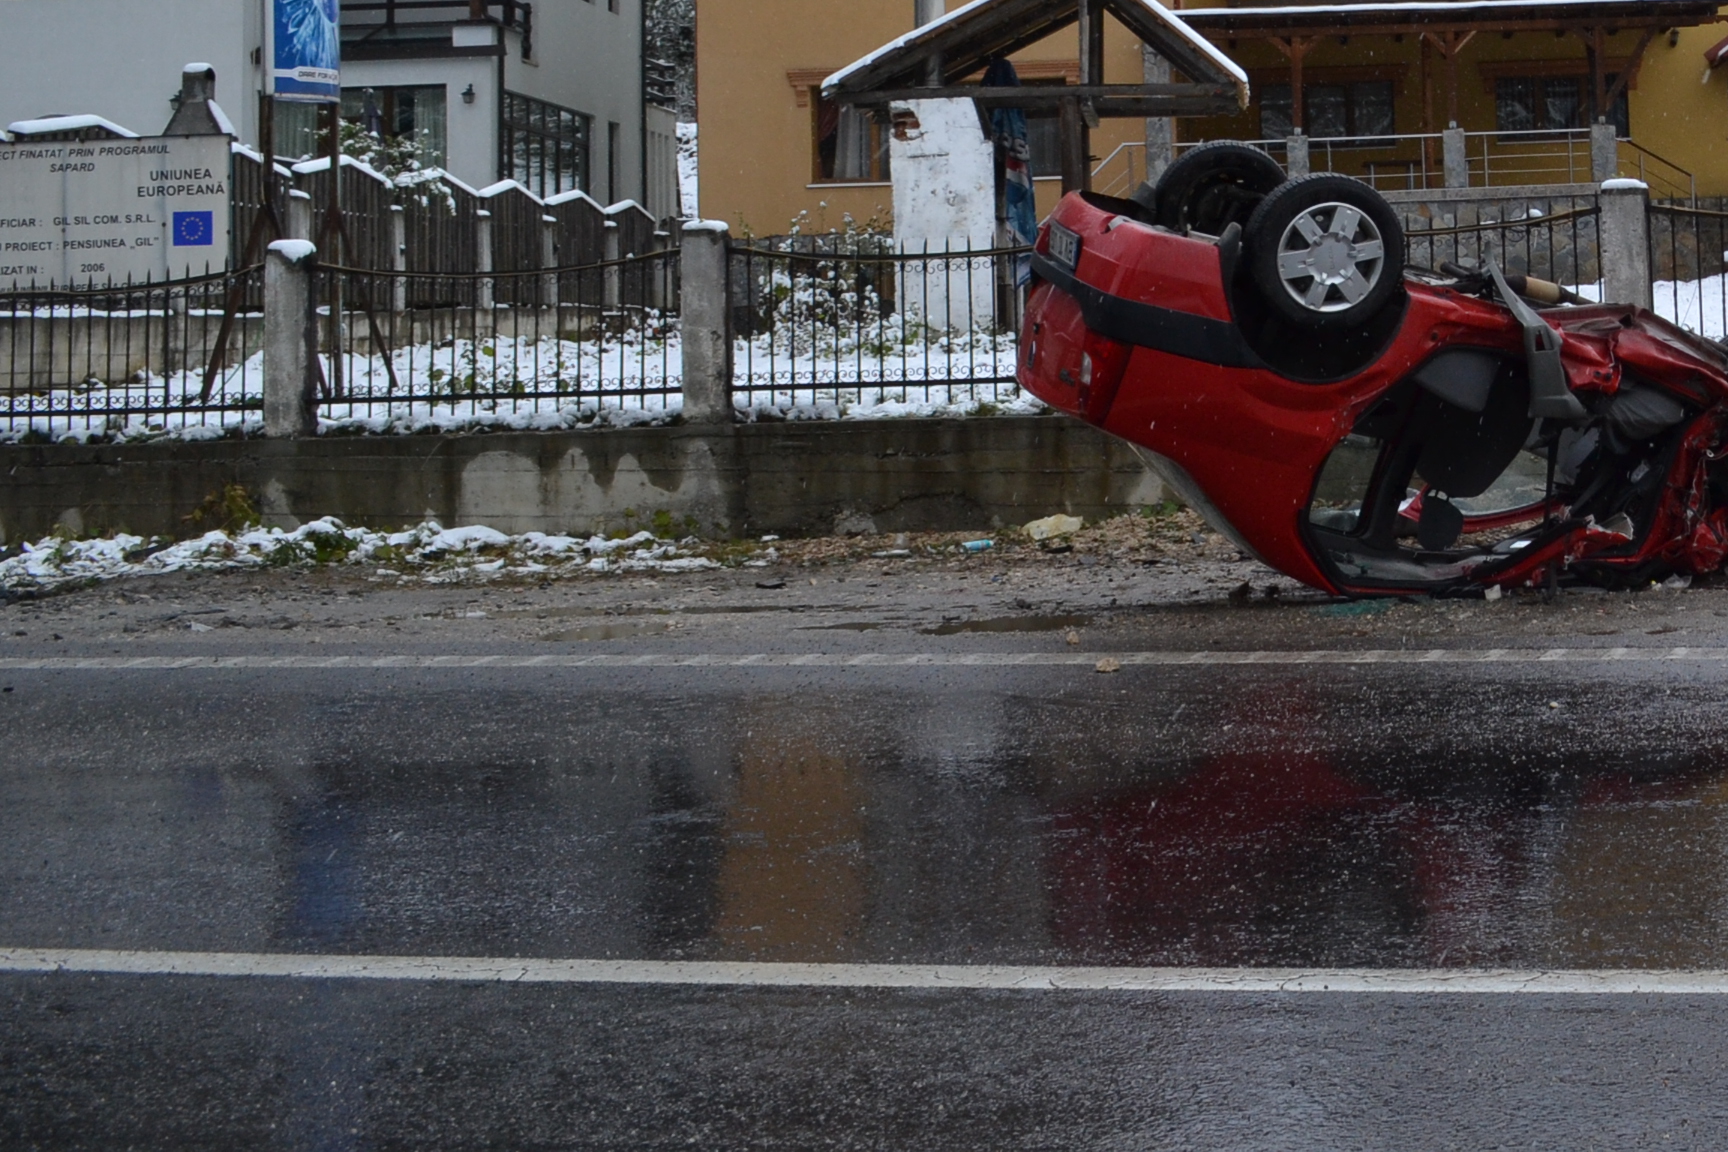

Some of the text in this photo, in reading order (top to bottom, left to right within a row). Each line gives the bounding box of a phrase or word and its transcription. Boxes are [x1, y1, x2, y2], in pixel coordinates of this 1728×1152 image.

[19, 149, 63, 159] FINATAT
[68, 148, 95, 158] PRIN
[99, 145, 170, 156] PROGRAMUL
[50, 163, 96, 173] SAPARD
[150, 168, 213, 182] UNIUNEA
[137, 181, 225, 198] EUROPEANĂ
[53, 216, 71, 226] GIL
[74, 216, 90, 226] SIL
[93, 214, 122, 225] COM.
[125, 214, 156, 224] S.R.L.
[5, 241, 53, 252] PROIECT
[63, 239, 126, 250] PENSIUNEA
[26, 265, 38, 275] IN
[80, 263, 105, 273] 2006
